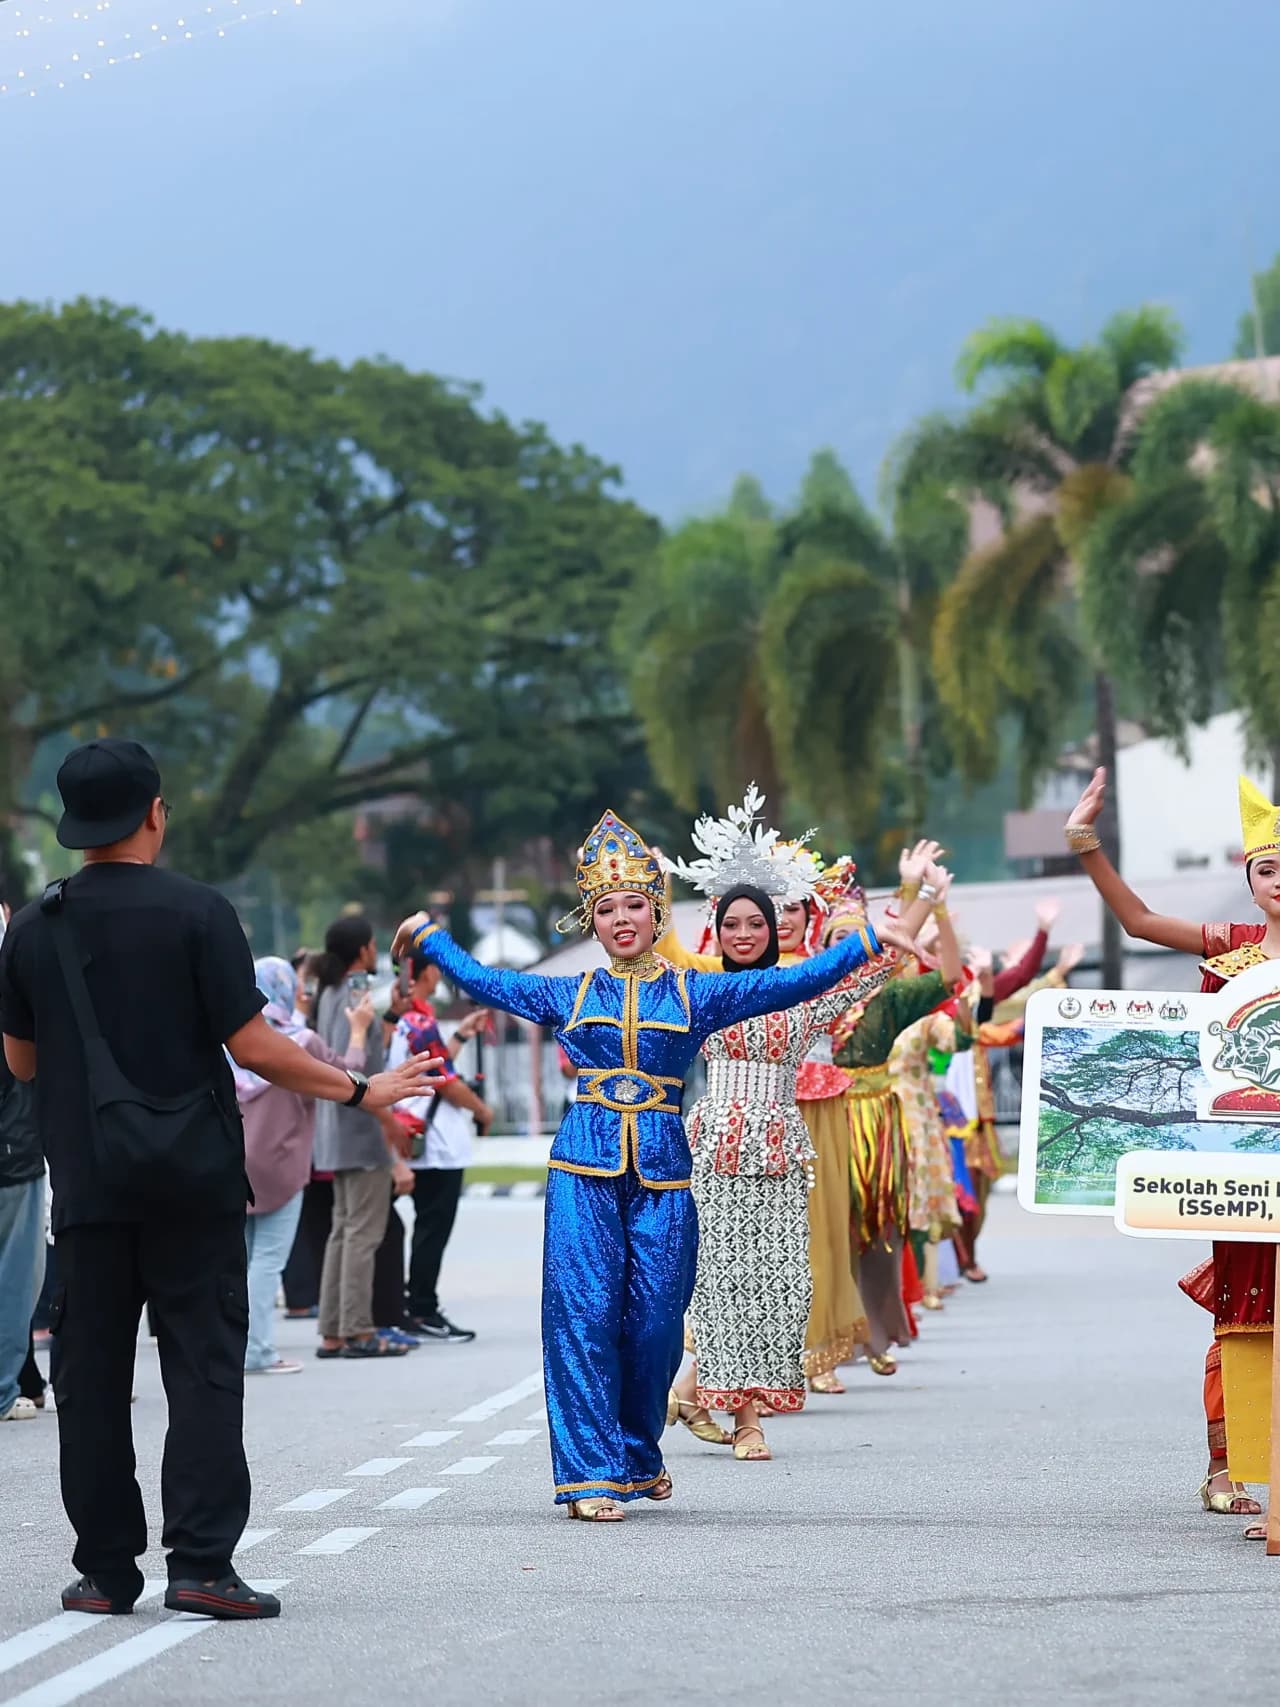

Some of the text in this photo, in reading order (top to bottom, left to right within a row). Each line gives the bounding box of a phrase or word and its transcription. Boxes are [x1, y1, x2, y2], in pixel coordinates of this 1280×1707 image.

[1133, 1177, 1218, 1196] Sekolah
[1224, 1180, 1270, 1197] Seni
[1178, 1197, 1274, 1221] (SSeMP),
